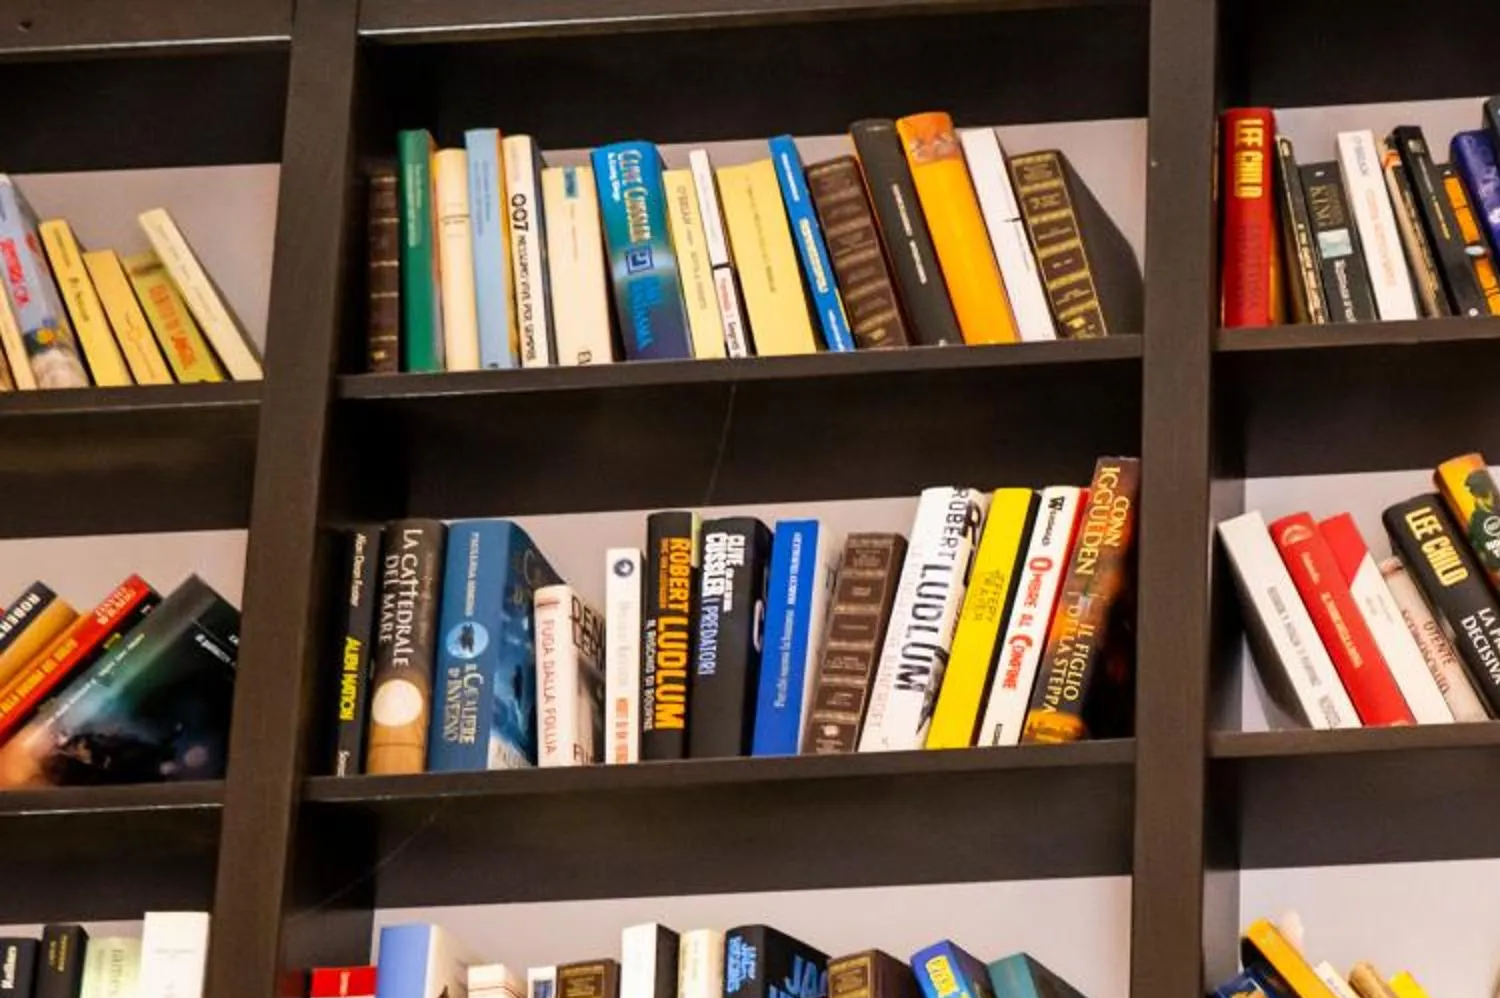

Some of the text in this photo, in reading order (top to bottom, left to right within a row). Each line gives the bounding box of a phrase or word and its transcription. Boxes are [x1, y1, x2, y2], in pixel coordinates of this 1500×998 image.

[725, 534, 746, 568] CLIVE
[1074, 466, 1121, 576] IGGULDEN
[701, 532, 728, 598] CUSSLER
[893, 488, 970, 693] ROBERT LUDLUM
[1420, 535, 1469, 587] CHILD
[391, 553, 420, 669] CATTEDRALE
[654, 537, 690, 730] ROBERT LUDLUM
[697, 605, 719, 677] PREDATORI
[1475, 607, 1496, 624] LA
[1041, 656, 1069, 714] STEPPA
[1062, 642, 1089, 701] FIGLIO
